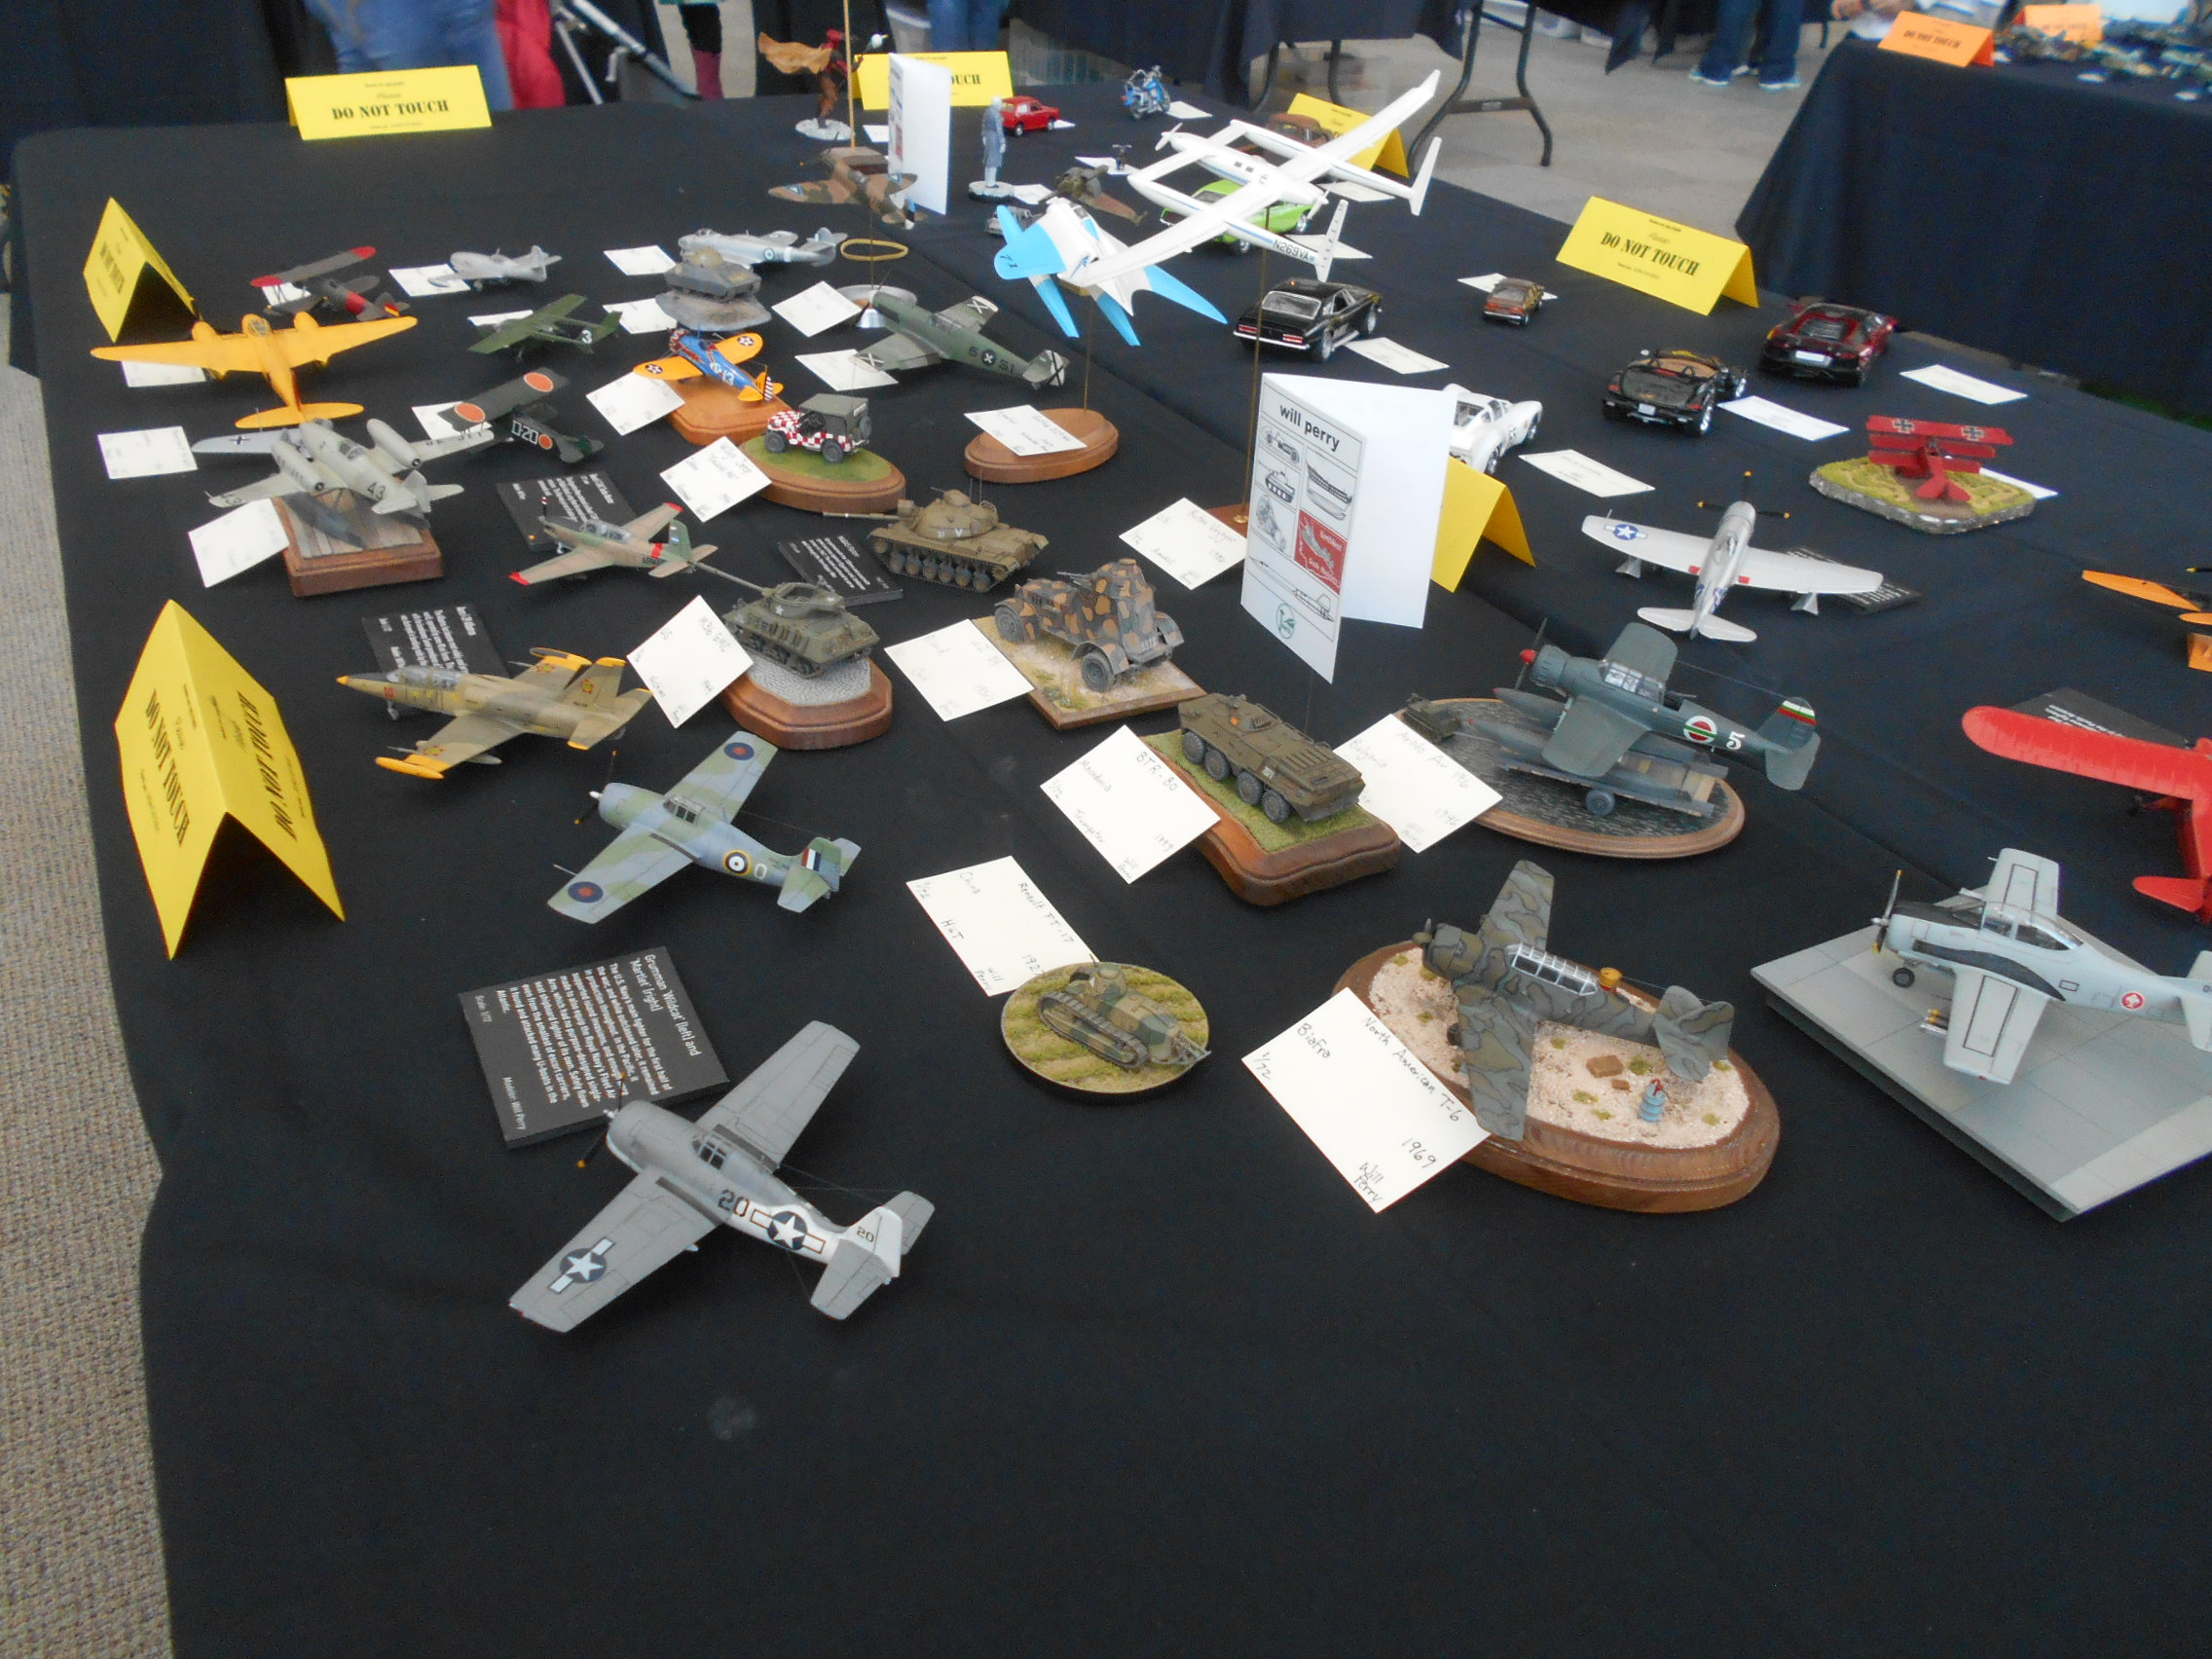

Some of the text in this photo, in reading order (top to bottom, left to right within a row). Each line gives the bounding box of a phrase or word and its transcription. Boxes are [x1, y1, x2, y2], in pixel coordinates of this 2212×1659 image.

[332, 99, 449, 121] DO NOT TOUCH
[1600, 231, 1620, 247] DO
[1620, 238, 1650, 259] NOT
[1652, 247, 1701, 276] TOUCH
[581, 329, 593, 345] 3
[1279, 403, 1341, 453] will perry
[237, 689, 274, 760] TOUCH
[1726, 731, 1746, 751] 5
[146, 689, 190, 848] DO NOT TOUCH
[256, 754, 287, 807] NOT
[270, 800, 297, 842] DO
[528, 997, 537, 1012] from
[609, 963, 618, 974] The
[633, 1018, 646, 1037] fighter
[645, 954, 666, 989] Grumman
[685, 1041, 701, 1055] and
[517, 1009, 529, 1019] and
[533, 1012, 541, 1021] the
[521, 1019, 537, 1044] attacked
[536, 1022, 551, 1046] smallest
[1297, 1022, 1331, 1059] Biafra
[531, 1045, 541, 1060] many
[549, 1020, 563, 1040] fighter
[570, 1071, 582, 1089] Safely
[577, 1089, 589, 1107] flown
[1253, 1051, 1272, 1082] 1/72
[1362, 1016, 1462, 1123] North American T-6
[548, 1092, 558, 1103] the
[600, 1072, 612, 1088] Fleet
[606, 1089, 615, 1098] Air
[511, 1101, 522, 1113] Will
[515, 1113, 526, 1129] Perry
[1401, 1137, 1437, 1169] 1969
[1358, 1161, 1384, 1185] Will
[1353, 1174, 1383, 1203] Perry
[718, 1189, 750, 1218] 20
[856, 1226, 874, 1243] 20
